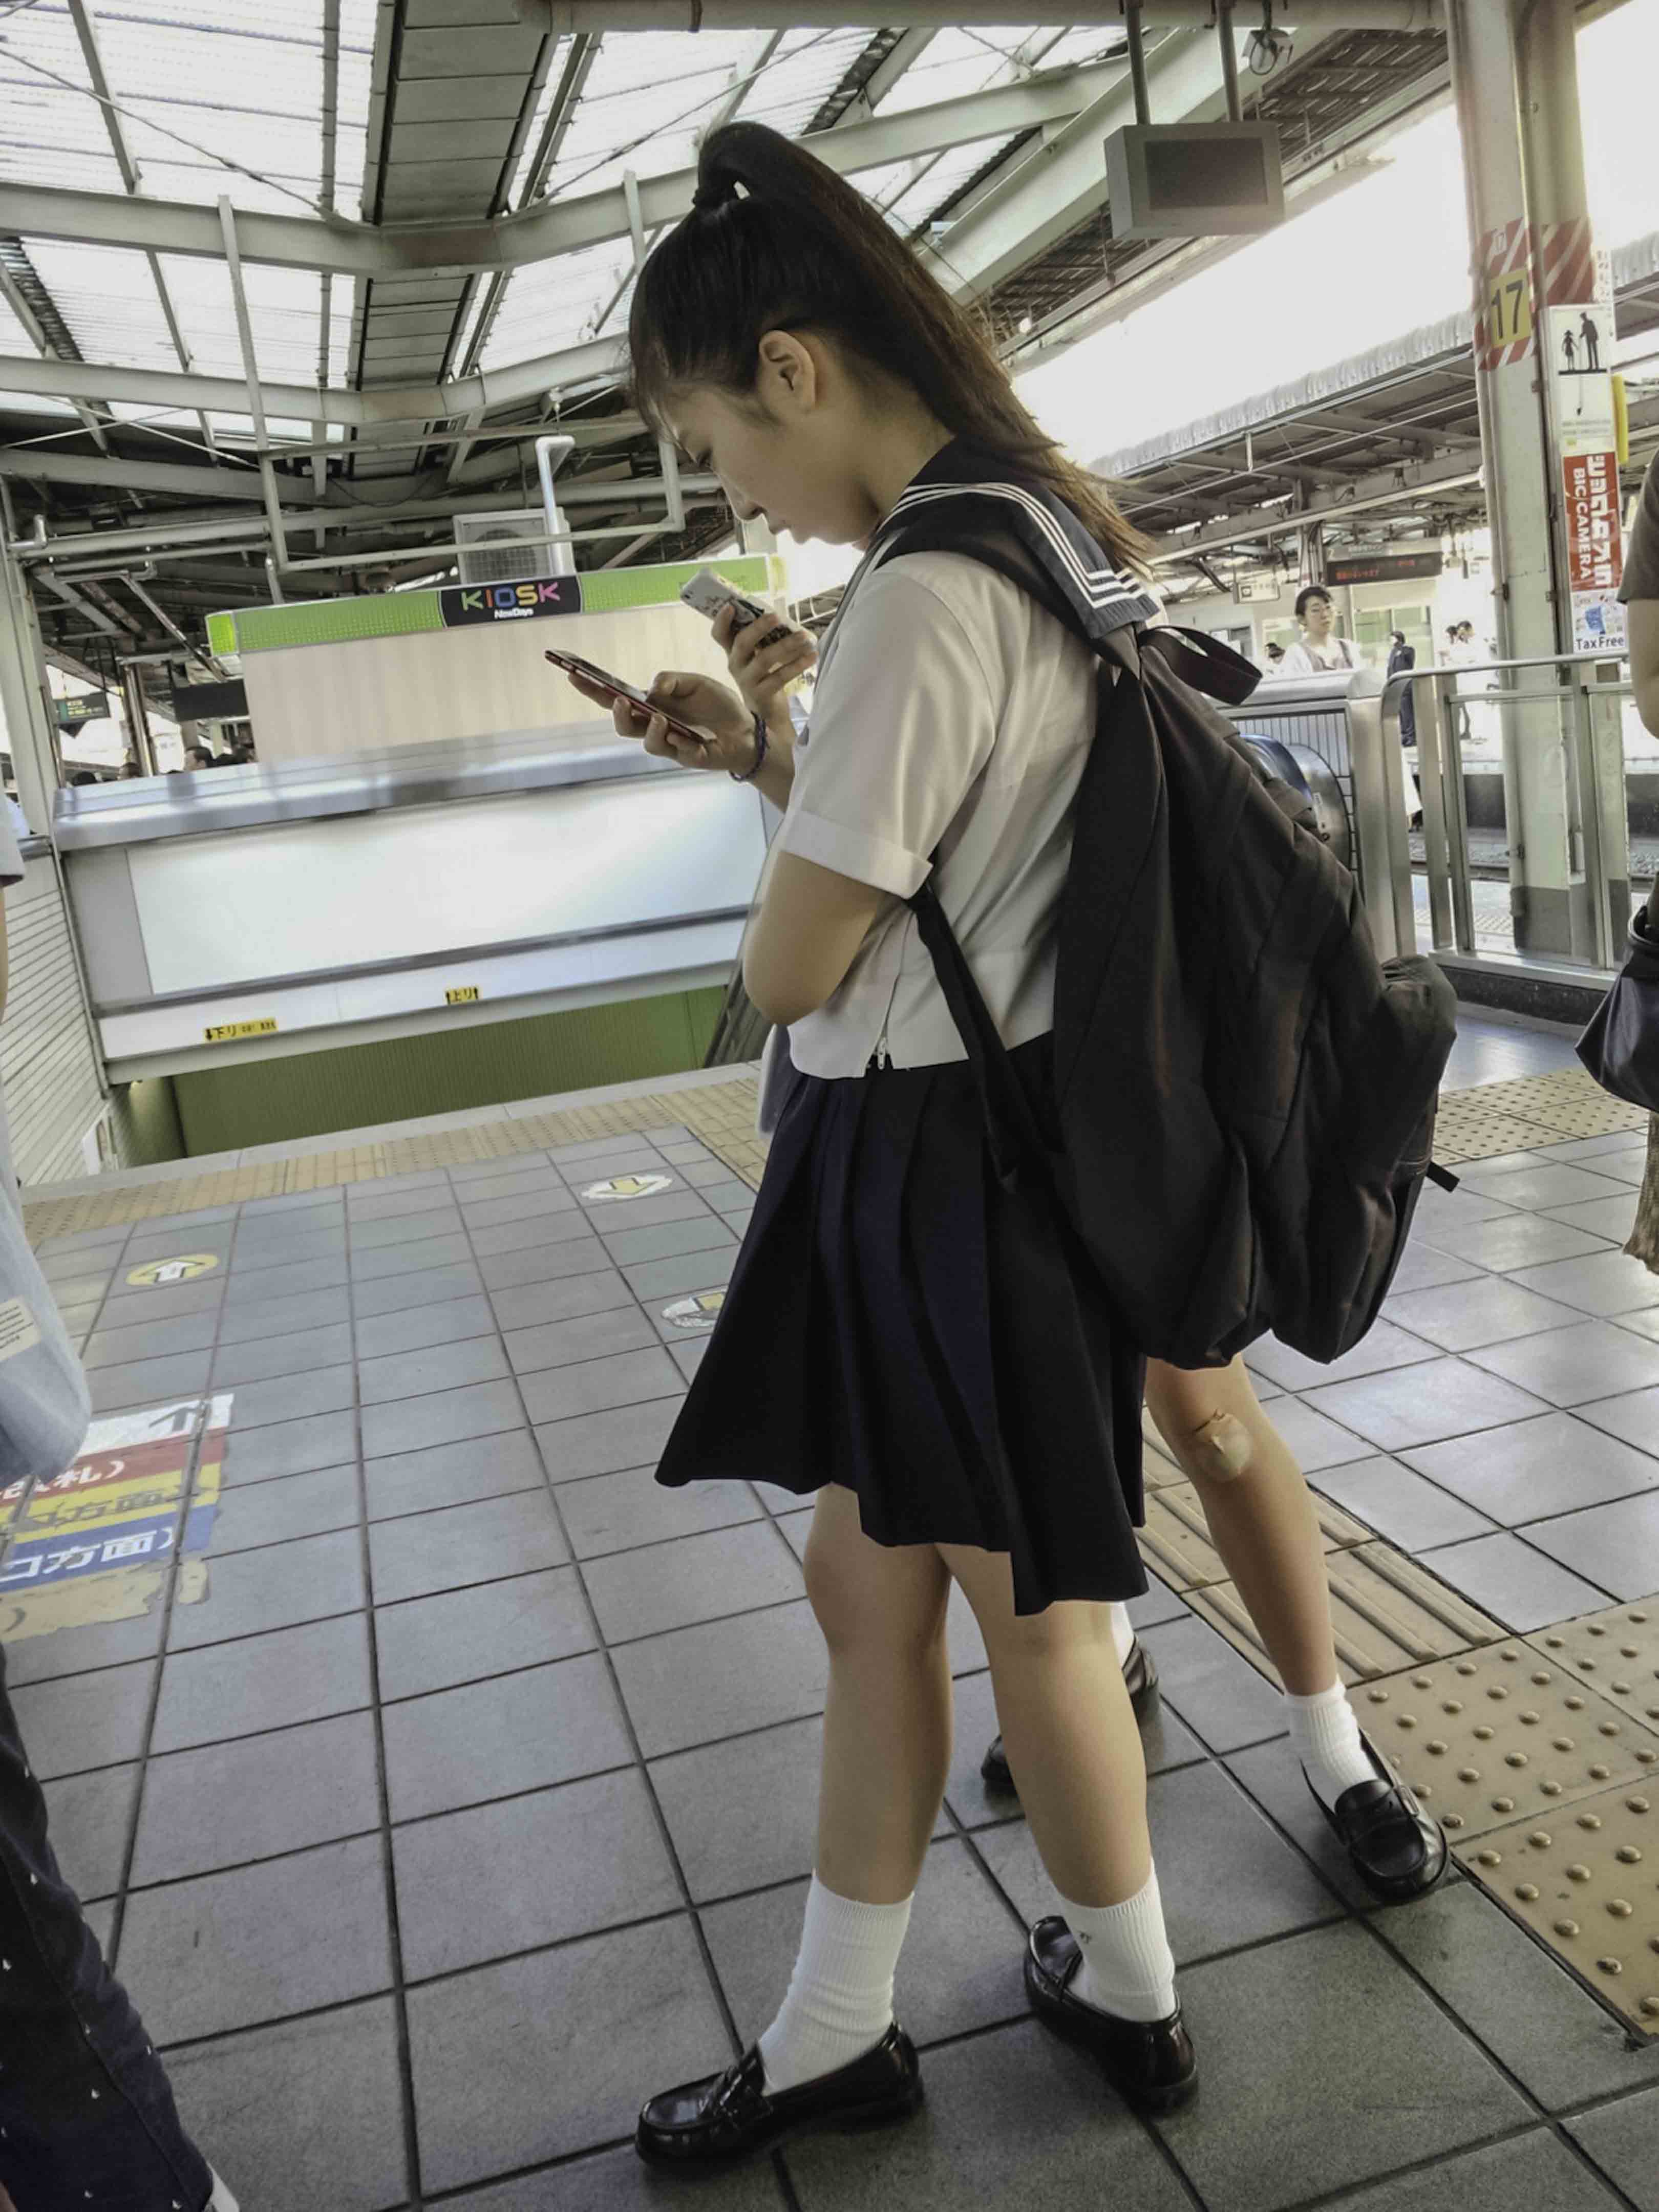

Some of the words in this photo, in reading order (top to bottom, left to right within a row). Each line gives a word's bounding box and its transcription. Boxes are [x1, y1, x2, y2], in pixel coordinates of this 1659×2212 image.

[1491, 280, 1523, 339] 17
[1573, 467, 1587, 497] BIC
[1576, 503, 1592, 580] CAMERA
[461, 582, 561, 611] KIOSK
[1576, 639, 1597, 650] Tax
[1599, 636, 1624, 648] Free
